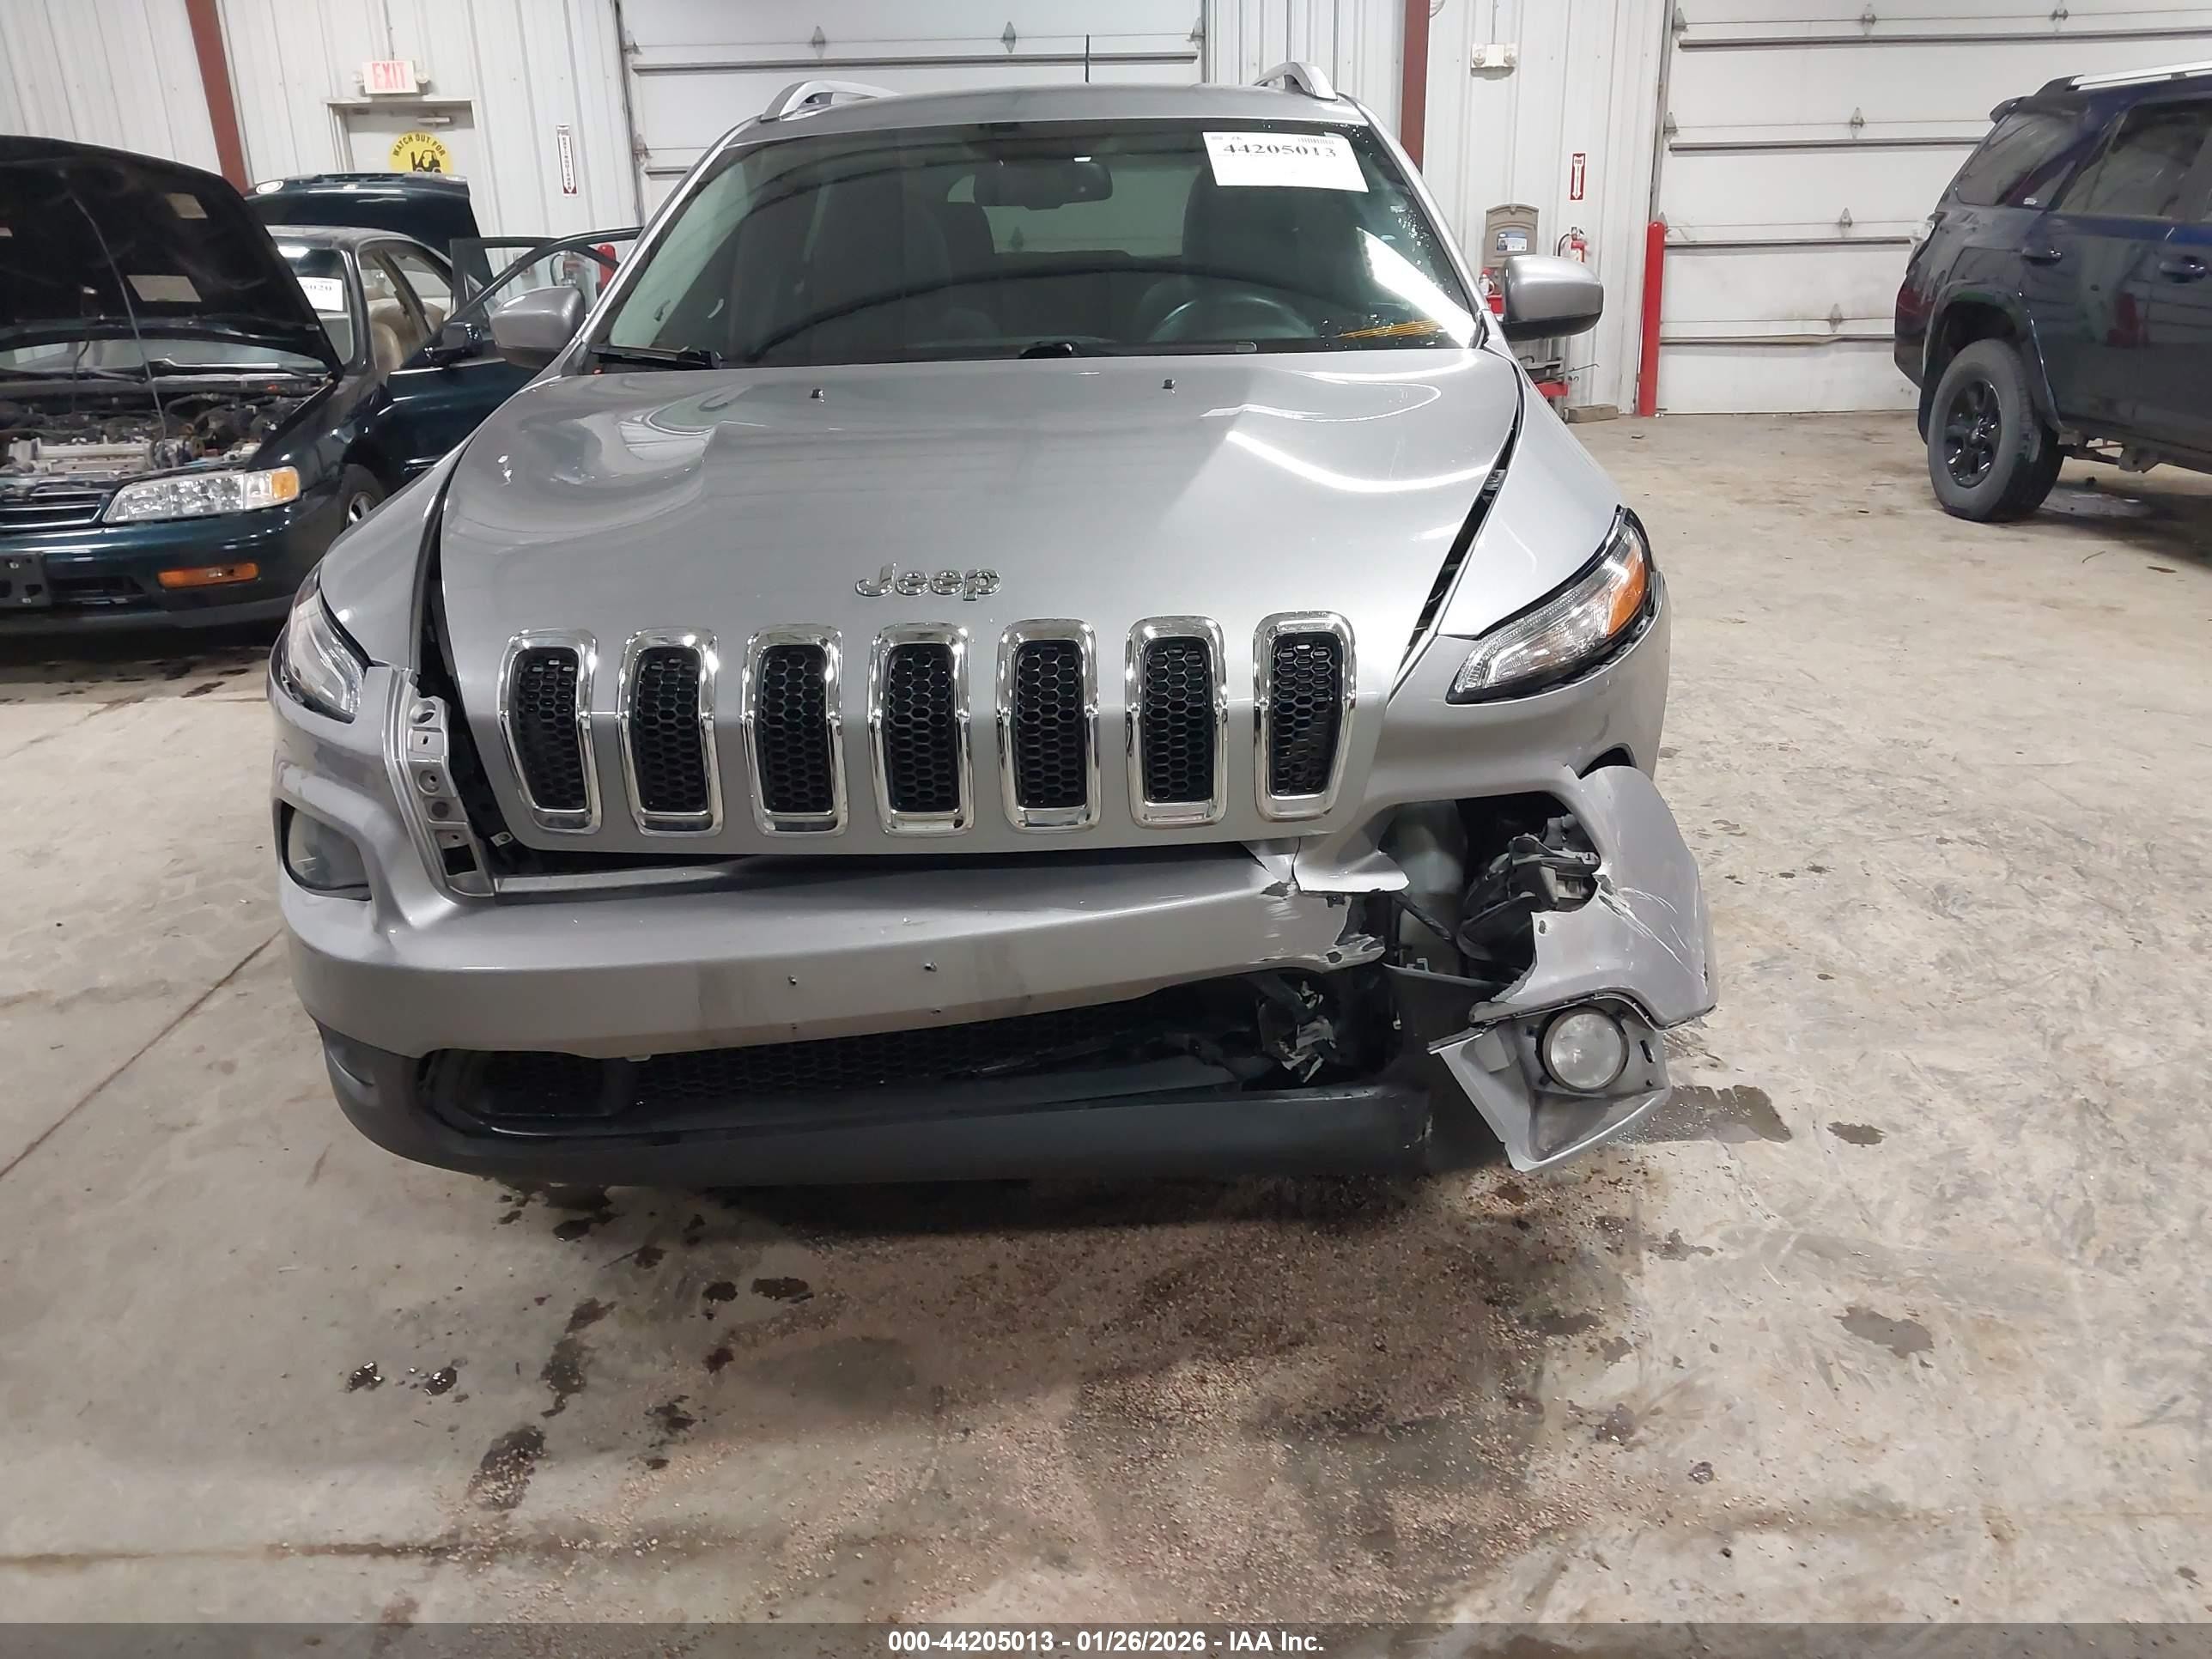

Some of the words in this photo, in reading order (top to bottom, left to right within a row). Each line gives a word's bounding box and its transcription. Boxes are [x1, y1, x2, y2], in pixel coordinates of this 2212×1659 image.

[371, 62, 406, 89] EXIT
[392, 134, 413, 156] WATCH
[415, 133, 431, 143] OUT
[432, 140, 446, 156] FOR
[1223, 139, 1337, 158] 44205013
[855, 562, 1002, 601] Jeep
